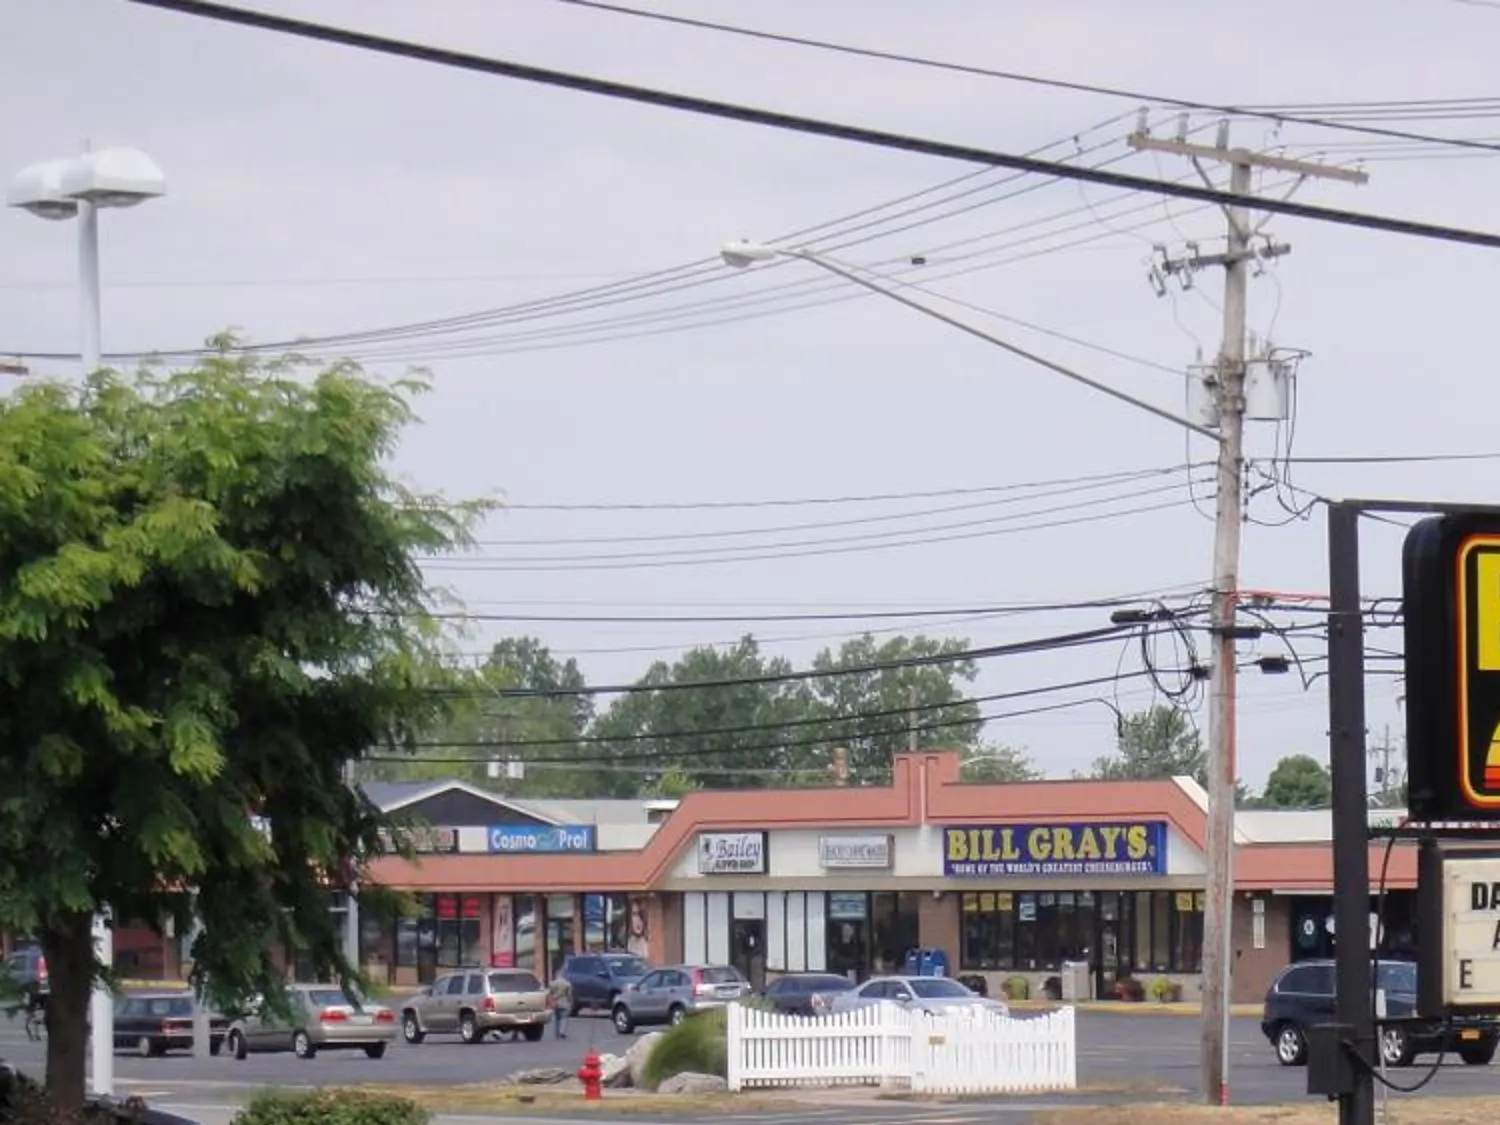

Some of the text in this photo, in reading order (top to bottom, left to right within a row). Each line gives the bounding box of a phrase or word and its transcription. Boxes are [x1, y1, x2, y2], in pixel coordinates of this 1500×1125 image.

[491, 828, 537, 850] Cosmo
[947, 826, 1148, 861] BILL GRAY'S
[1459, 959, 1473, 989] E
